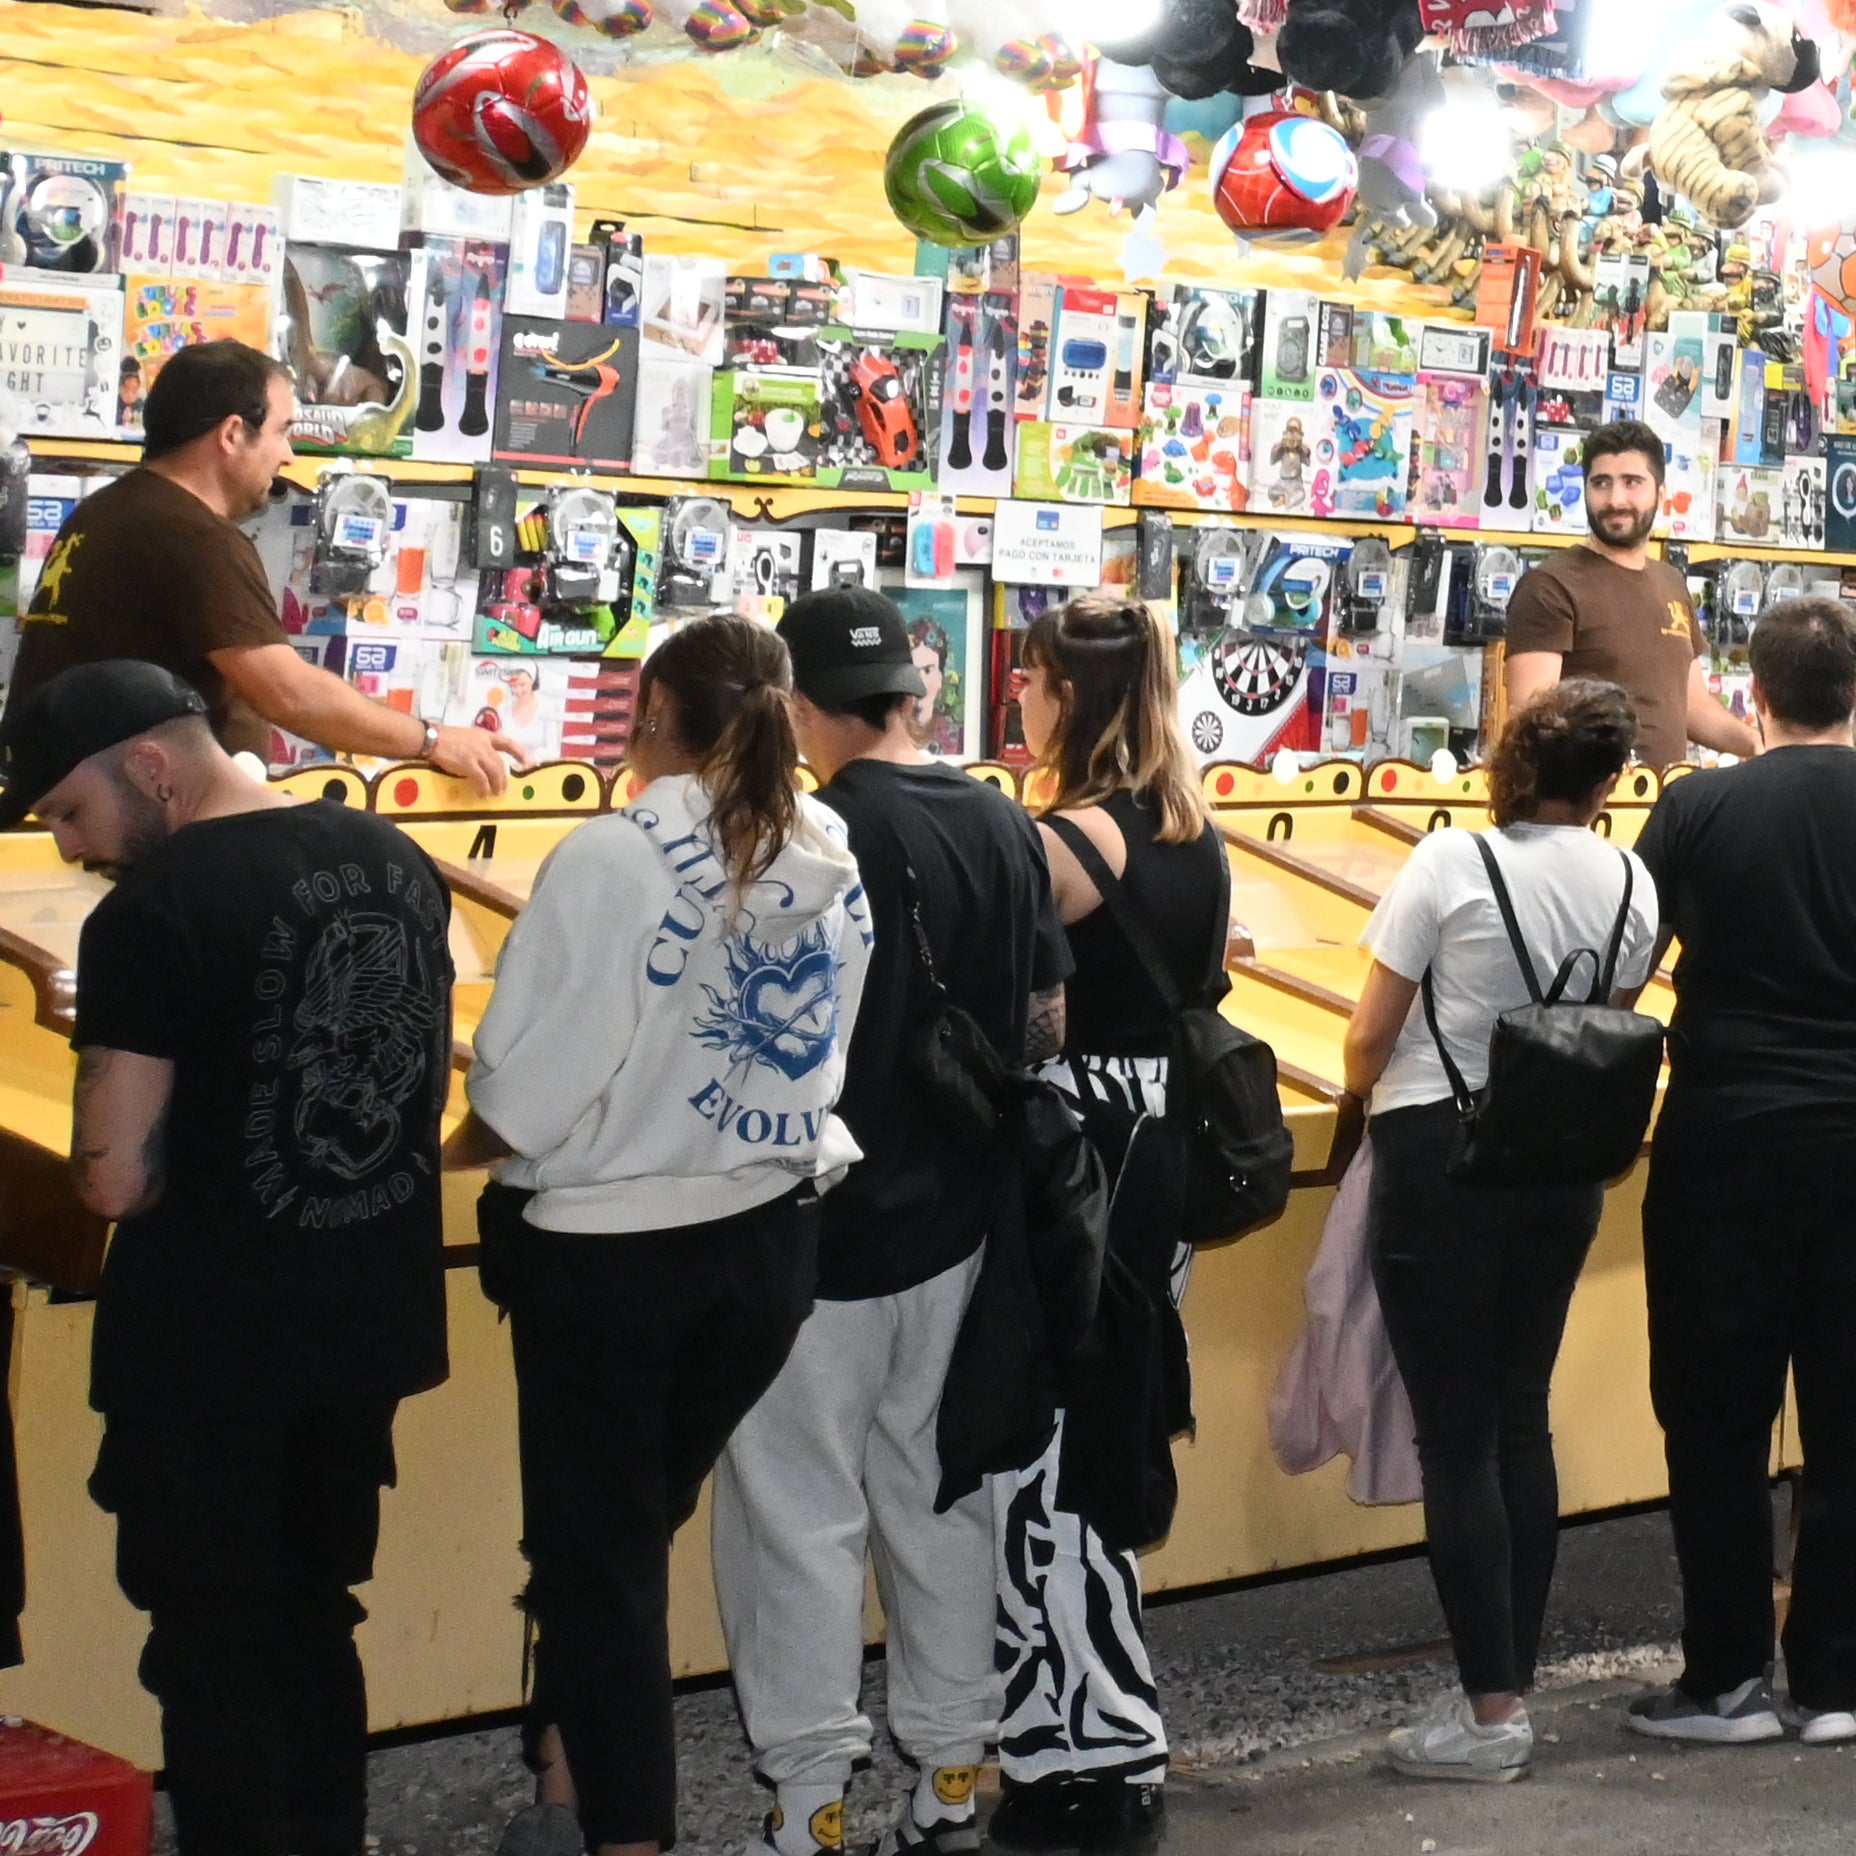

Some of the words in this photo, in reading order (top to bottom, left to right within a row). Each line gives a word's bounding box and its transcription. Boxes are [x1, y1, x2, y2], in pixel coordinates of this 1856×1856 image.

[35, 157, 106, 176] PRITECH
[489, 525, 504, 557] 6
[1020, 538, 1076, 549] ACEPTAMOS
[999, 549, 1027, 561] PAGO
[1028, 551, 1049, 562] CON
[1050, 552, 1096, 565] TARJETA
[1289, 544, 1340, 558] PRITECH
[566, 629, 599, 646] GUN
[850, 626, 880, 641] VANS
[1246, 699, 1253, 711] 3
[292, 862, 372, 917] FOR
[252, 915, 300, 1064] SLOW
[687, 1077, 826, 1145] EVOLV
[244, 1078, 284, 1206] MADE
[299, 1171, 416, 1230] NOMAD
